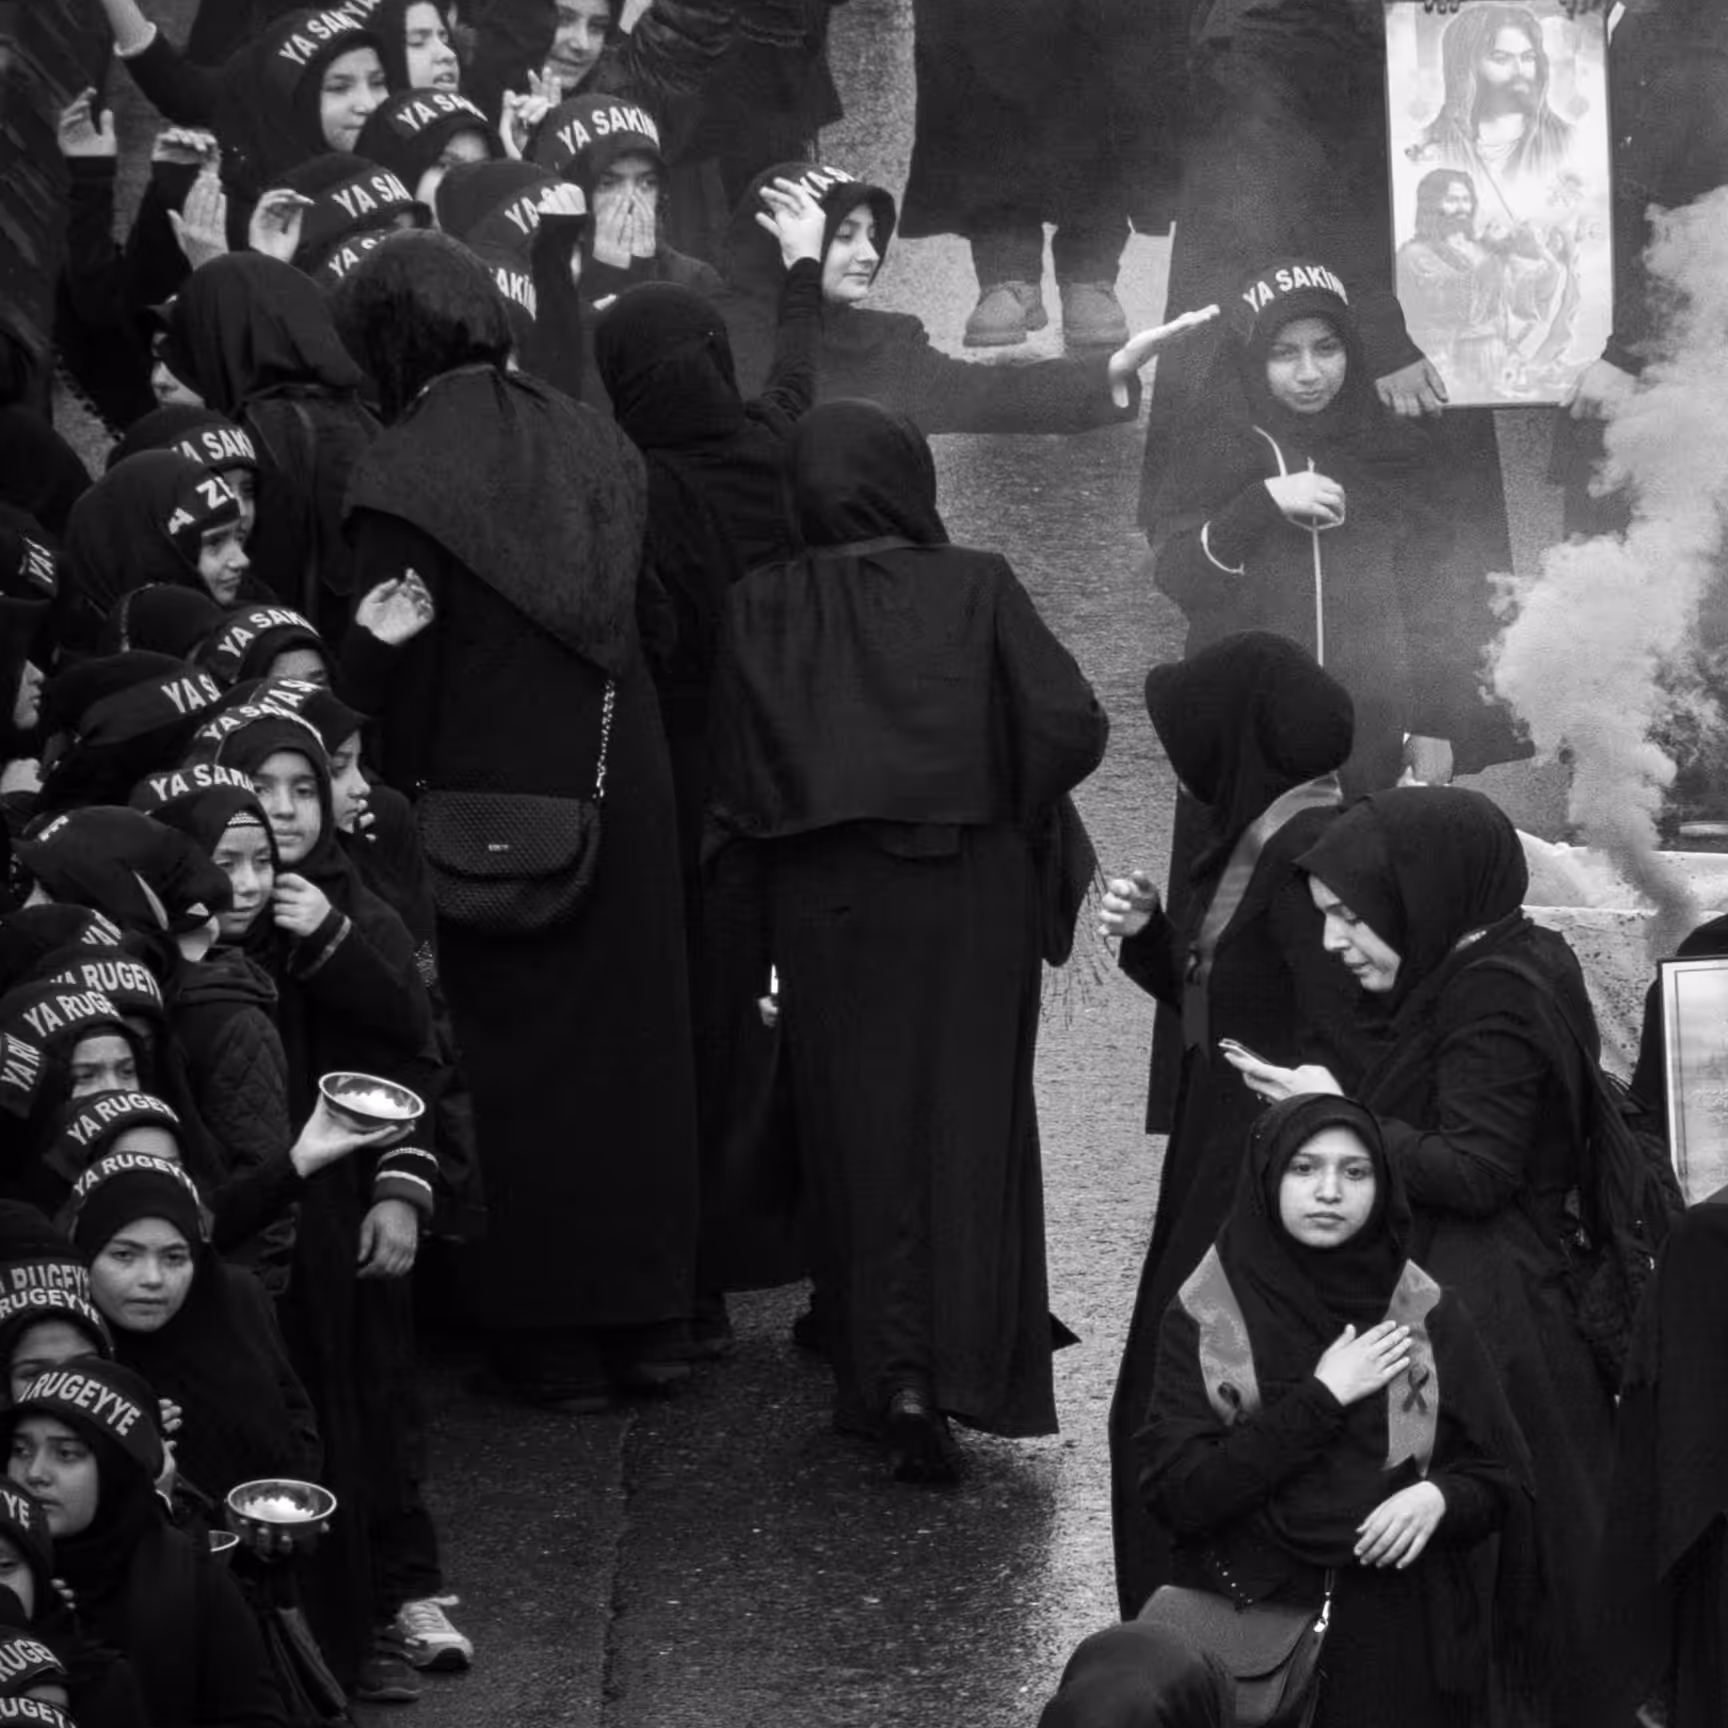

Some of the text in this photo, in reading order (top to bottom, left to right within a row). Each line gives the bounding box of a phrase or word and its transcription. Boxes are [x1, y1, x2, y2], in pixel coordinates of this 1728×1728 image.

[279, 34, 319, 65] YA
[396, 102, 438, 131] YA
[557, 120, 592, 155] YA
[332, 185, 378, 218] YA
[505, 196, 541, 235] YA
[329, 247, 359, 279] YA
[1243, 280, 1274, 314] YA
[217, 627, 254, 659] YA
[161, 677, 202, 714] YA
[203, 714, 240, 741] YA
[150, 772, 190, 802] YA
[23, 1000, 61, 1037] YA
[3, 1050, 41, 1092] YA
[67, 1111, 102, 1146] YA
[73, 1169, 99, 1198] YA
[30, 1371, 141, 1437] RUGEYYE
